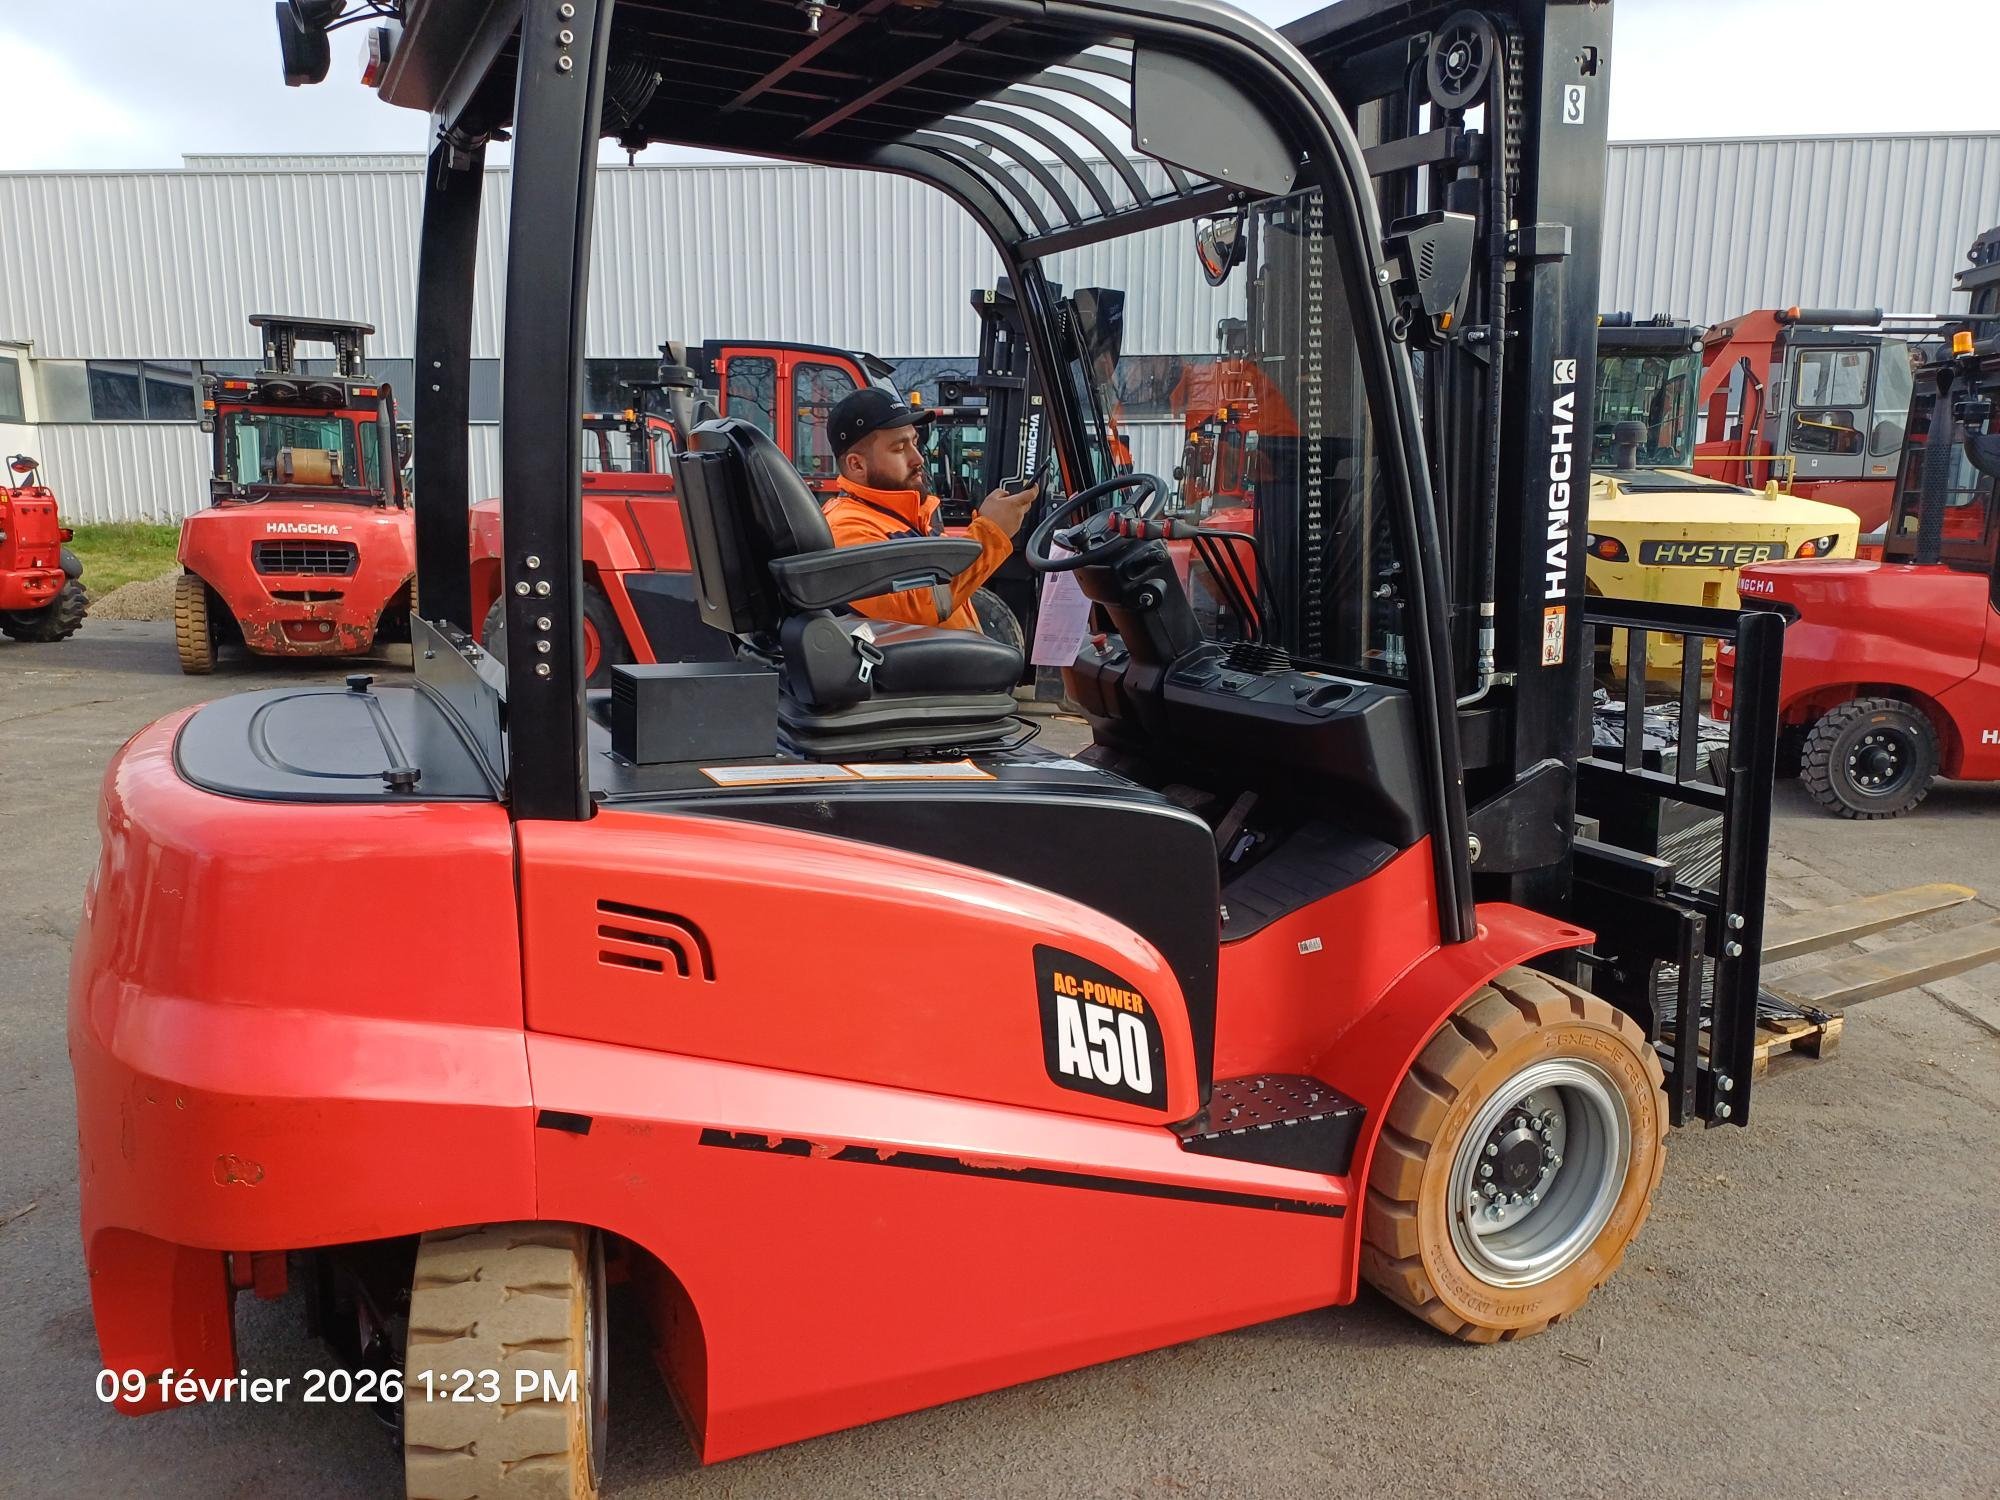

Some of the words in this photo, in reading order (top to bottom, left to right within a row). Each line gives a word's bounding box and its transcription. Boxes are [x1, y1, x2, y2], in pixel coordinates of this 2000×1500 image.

[1025, 413, 1040, 475] HANGCHA
[1546, 392, 1574, 599] HANGCHA
[266, 522, 339, 535] HANGCHA
[1654, 544, 1771, 564] HYSTER
[1738, 578, 1774, 593] NGCHA
[1981, 729, 2000, 744] H
[1053, 973, 1144, 1014] AC-POWER
[1057, 995, 1152, 1094] A50
